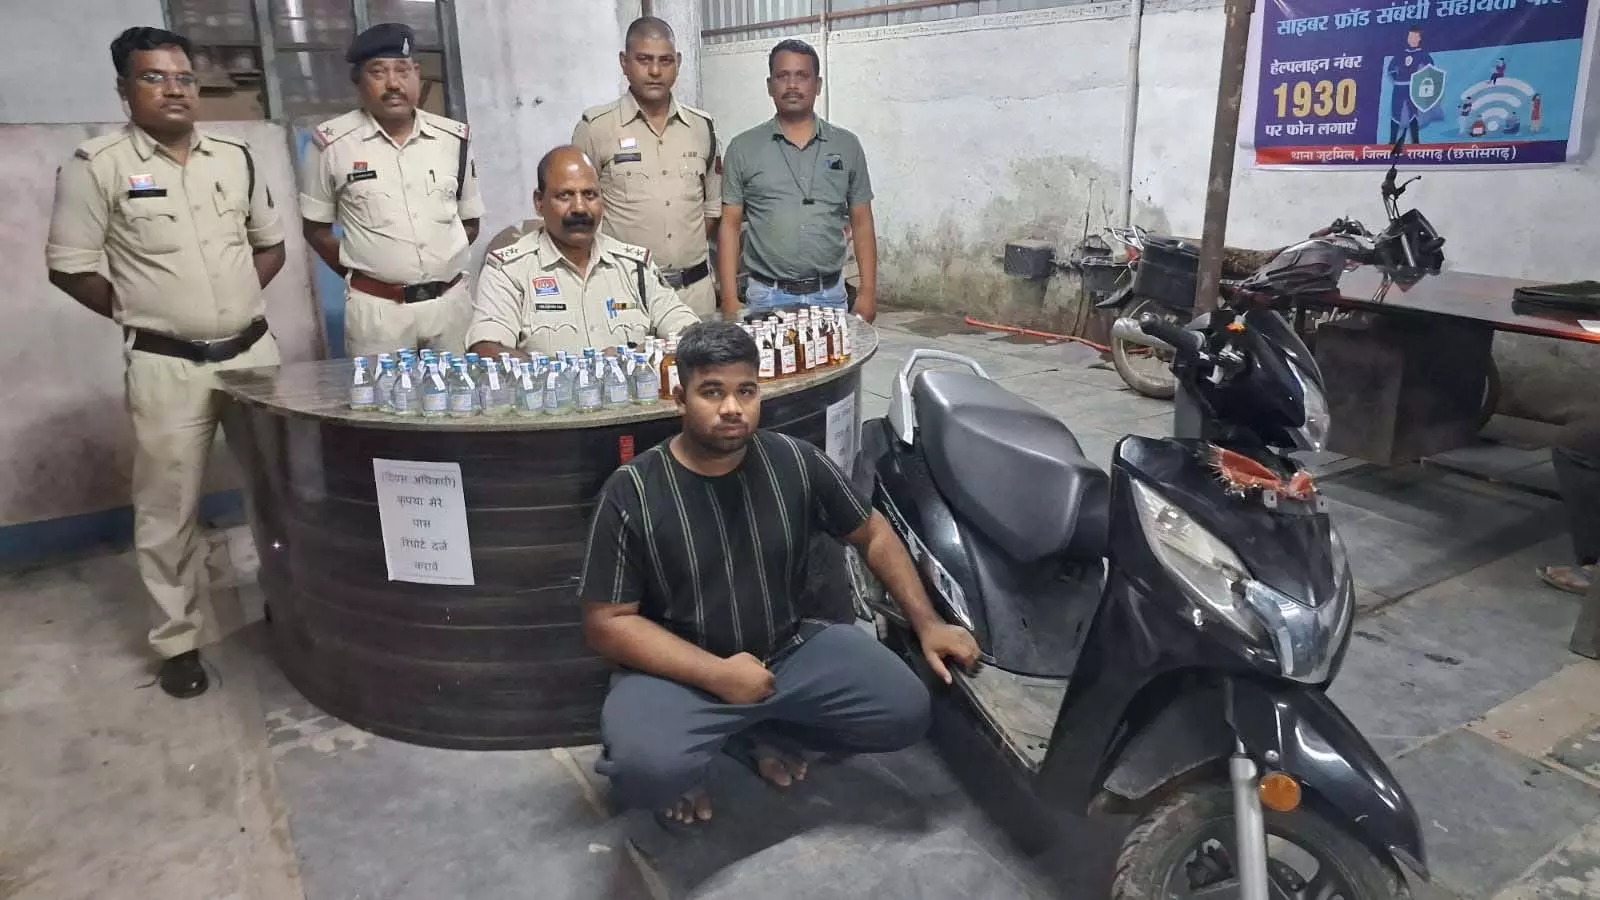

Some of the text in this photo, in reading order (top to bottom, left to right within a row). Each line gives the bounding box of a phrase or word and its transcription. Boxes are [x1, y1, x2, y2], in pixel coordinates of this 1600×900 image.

[1277, 16, 1329, 36] साइबर
[1334, 8, 1371, 29] फ्रॉड
[1376, 0, 1430, 24] संबंधी
[1270, 52, 1363, 75] हेल्पलाइन नंबर
[1273, 78, 1357, 118] 1930
[1265, 118, 1357, 136] पर फोन लगाएं
[1291, 151, 1313, 161] थाना
[1362, 145, 1392, 160] जिला
